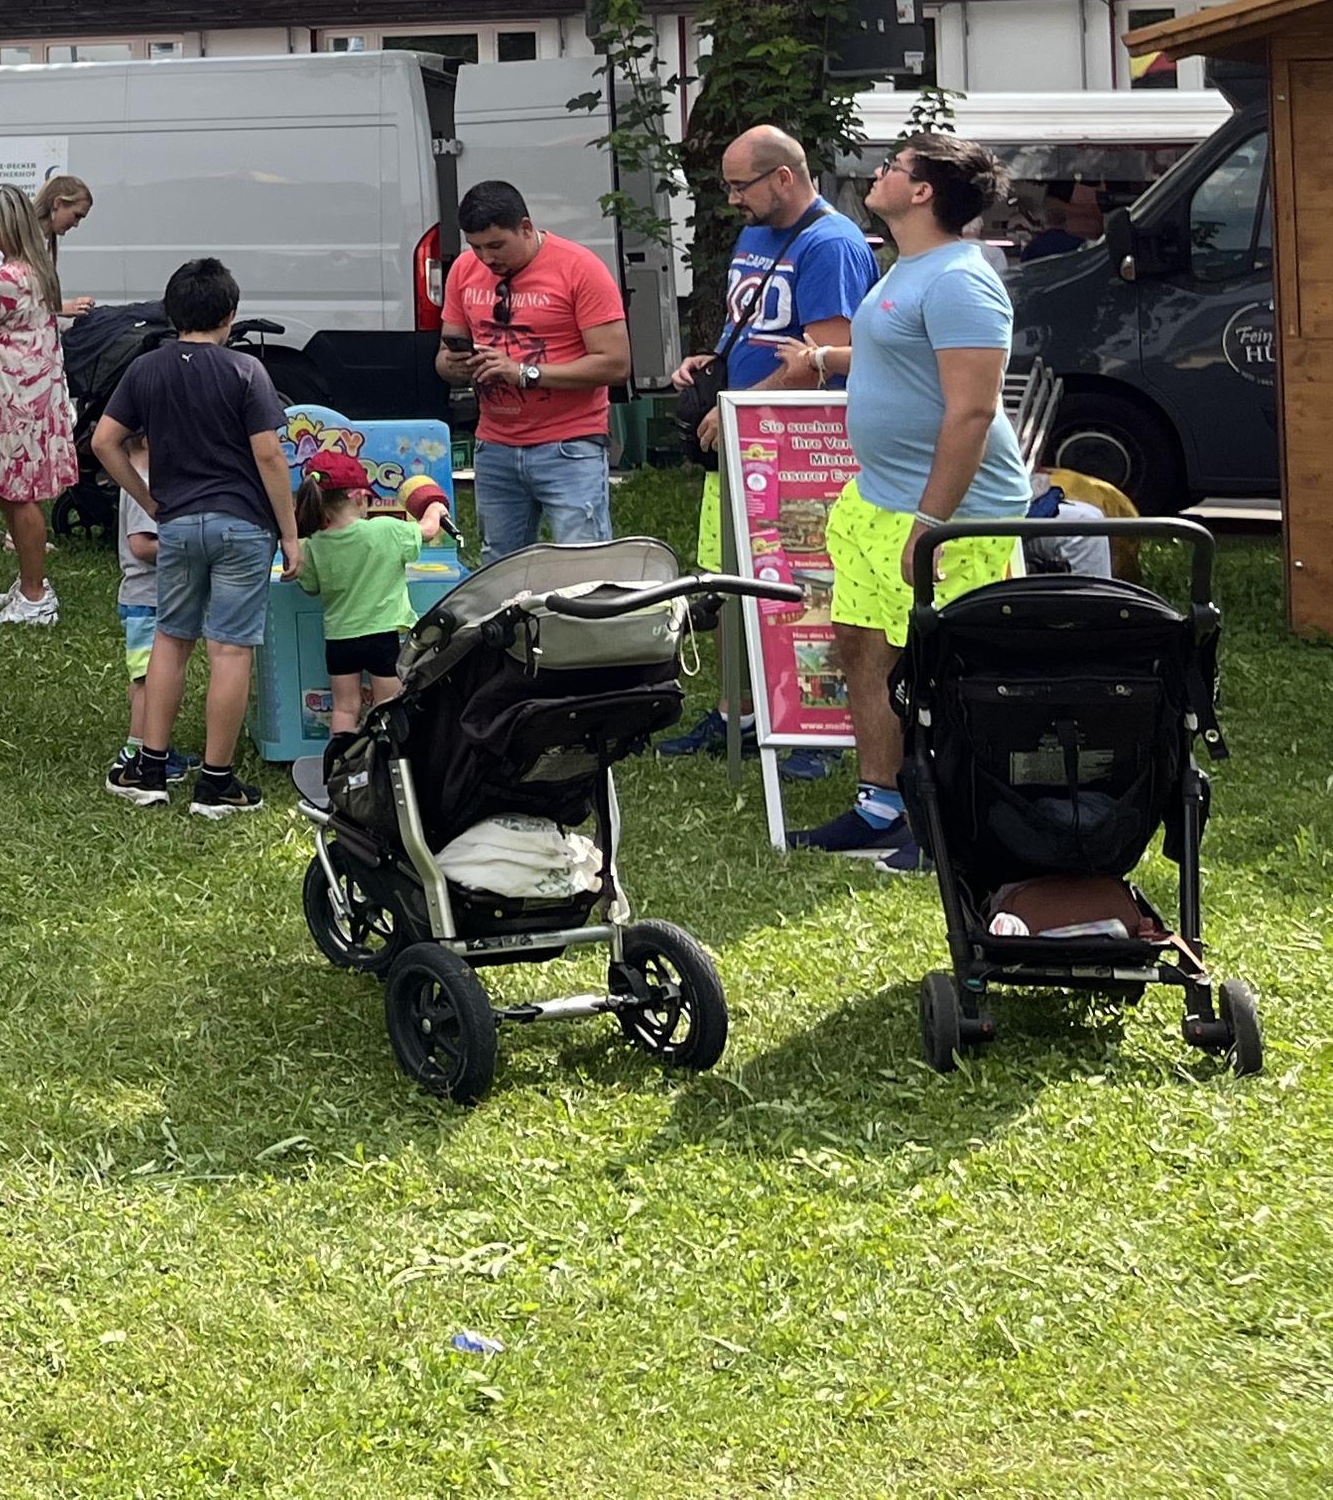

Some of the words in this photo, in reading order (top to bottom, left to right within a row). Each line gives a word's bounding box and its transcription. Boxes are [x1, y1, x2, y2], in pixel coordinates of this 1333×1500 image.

[760, 420, 784, 434] Sie
[788, 420, 843, 434] suchen
[792, 436, 822, 450] Ihre
[824, 436, 853, 450] Ver
